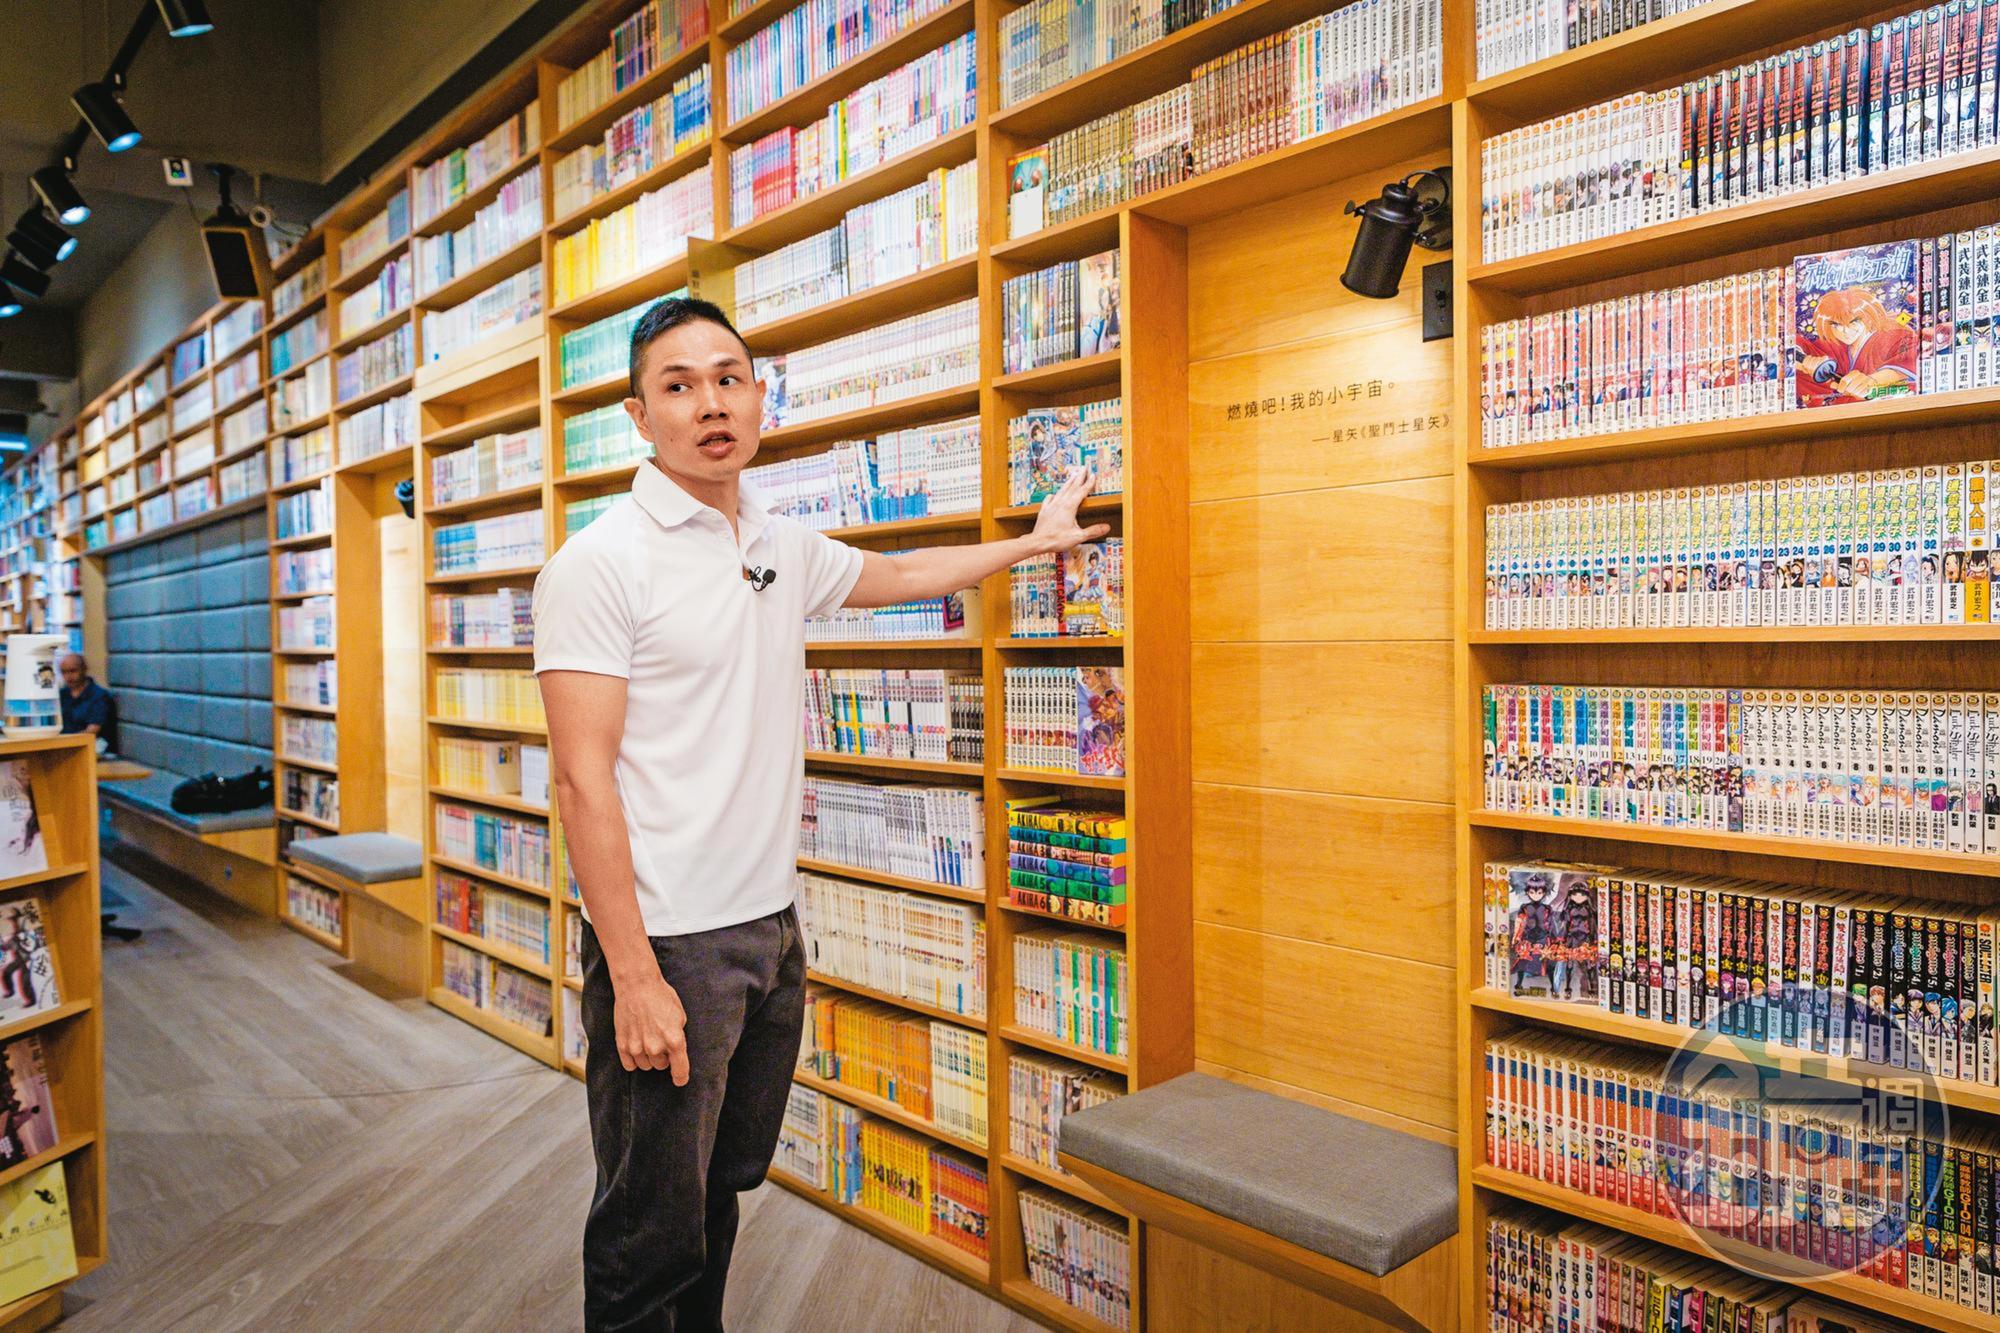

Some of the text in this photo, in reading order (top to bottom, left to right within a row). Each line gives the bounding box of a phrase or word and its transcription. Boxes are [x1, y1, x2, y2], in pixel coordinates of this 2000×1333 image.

[1982, 69, 1993, 80] 18
[1962, 74, 1973, 85] 17
[1946, 80, 1957, 90] 16
[1908, 89, 1919, 100] 14
[1926, 85, 1936, 96] 15
[1890, 94, 1901, 105] 13
[1870, 101, 1880, 112] 12
[1848, 107, 1856, 117] 11
[1814, 117, 1819, 126] 9
[1829, 112, 1839, 123] 10
[1781, 124, 1786, 133] 7
[1796, 121, 1801, 130] 8
[1766, 129, 1771, 138] 6
[1750, 134, 1755, 143] 5
[1840, 545, 1851, 553] 27
[1857, 543, 1868, 552] 28
[1874, 542, 1886, 552] 29
[1889, 542, 1900, 552] 30
[1906, 541, 1916, 550] 31
[1924, 540, 1936, 549] 32
[1735, 550, 1744, 558] 20
[1750, 549, 1759, 557] 21
[1763, 549, 1773, 557] 22
[1779, 548, 1789, 556] 23
[1793, 546, 1804, 555] 24
[1808, 546, 1819, 555] 25
[1824, 545, 1834, 554] 26
[1677, 553, 1686, 562] 16
[1692, 553, 1701, 561] 17
[1706, 552, 1715, 560] 18
[1721, 551, 1730, 560] 19
[1950, 586, 1958, 610] 武井宏之
[1974, 583, 1982, 612] 武井宏之
[1613, 752, 1623, 760] 12
[1651, 753, 1660, 761] 15
[1663, 754, 1673, 762] 16
[1676, 755, 1685, 763] 17
[1689, 756, 1699, 764] 18
[1702, 756, 1712, 764] 19
[1716, 757, 1726, 765] 20
[1869, 764, 1873, 772] 9
[1884, 765, 1892, 773] 10
[1901, 765, 1908, 774] 11
[1918, 766, 1926, 774] 12
[1934, 767, 1943, 775] 13
[1952, 768, 1957, 777] 1
[1970, 768, 1975, 777] 2
[1989, 769, 1994, 779] 3
[1017, 812, 1038, 825] AKIRA
[1017, 891, 1046, 909] AKIRA 6
[1770, 968, 1780, 977] 16
[1801, 973, 1811, 982] 18
[1834, 979, 1844, 987] 20
[1984, 994, 1988, 1002] 1
[1911, 1211, 1921, 1223] 01
[1944, 1219, 1954, 1232] 03
[1961, 1223, 1971, 1236] 04
